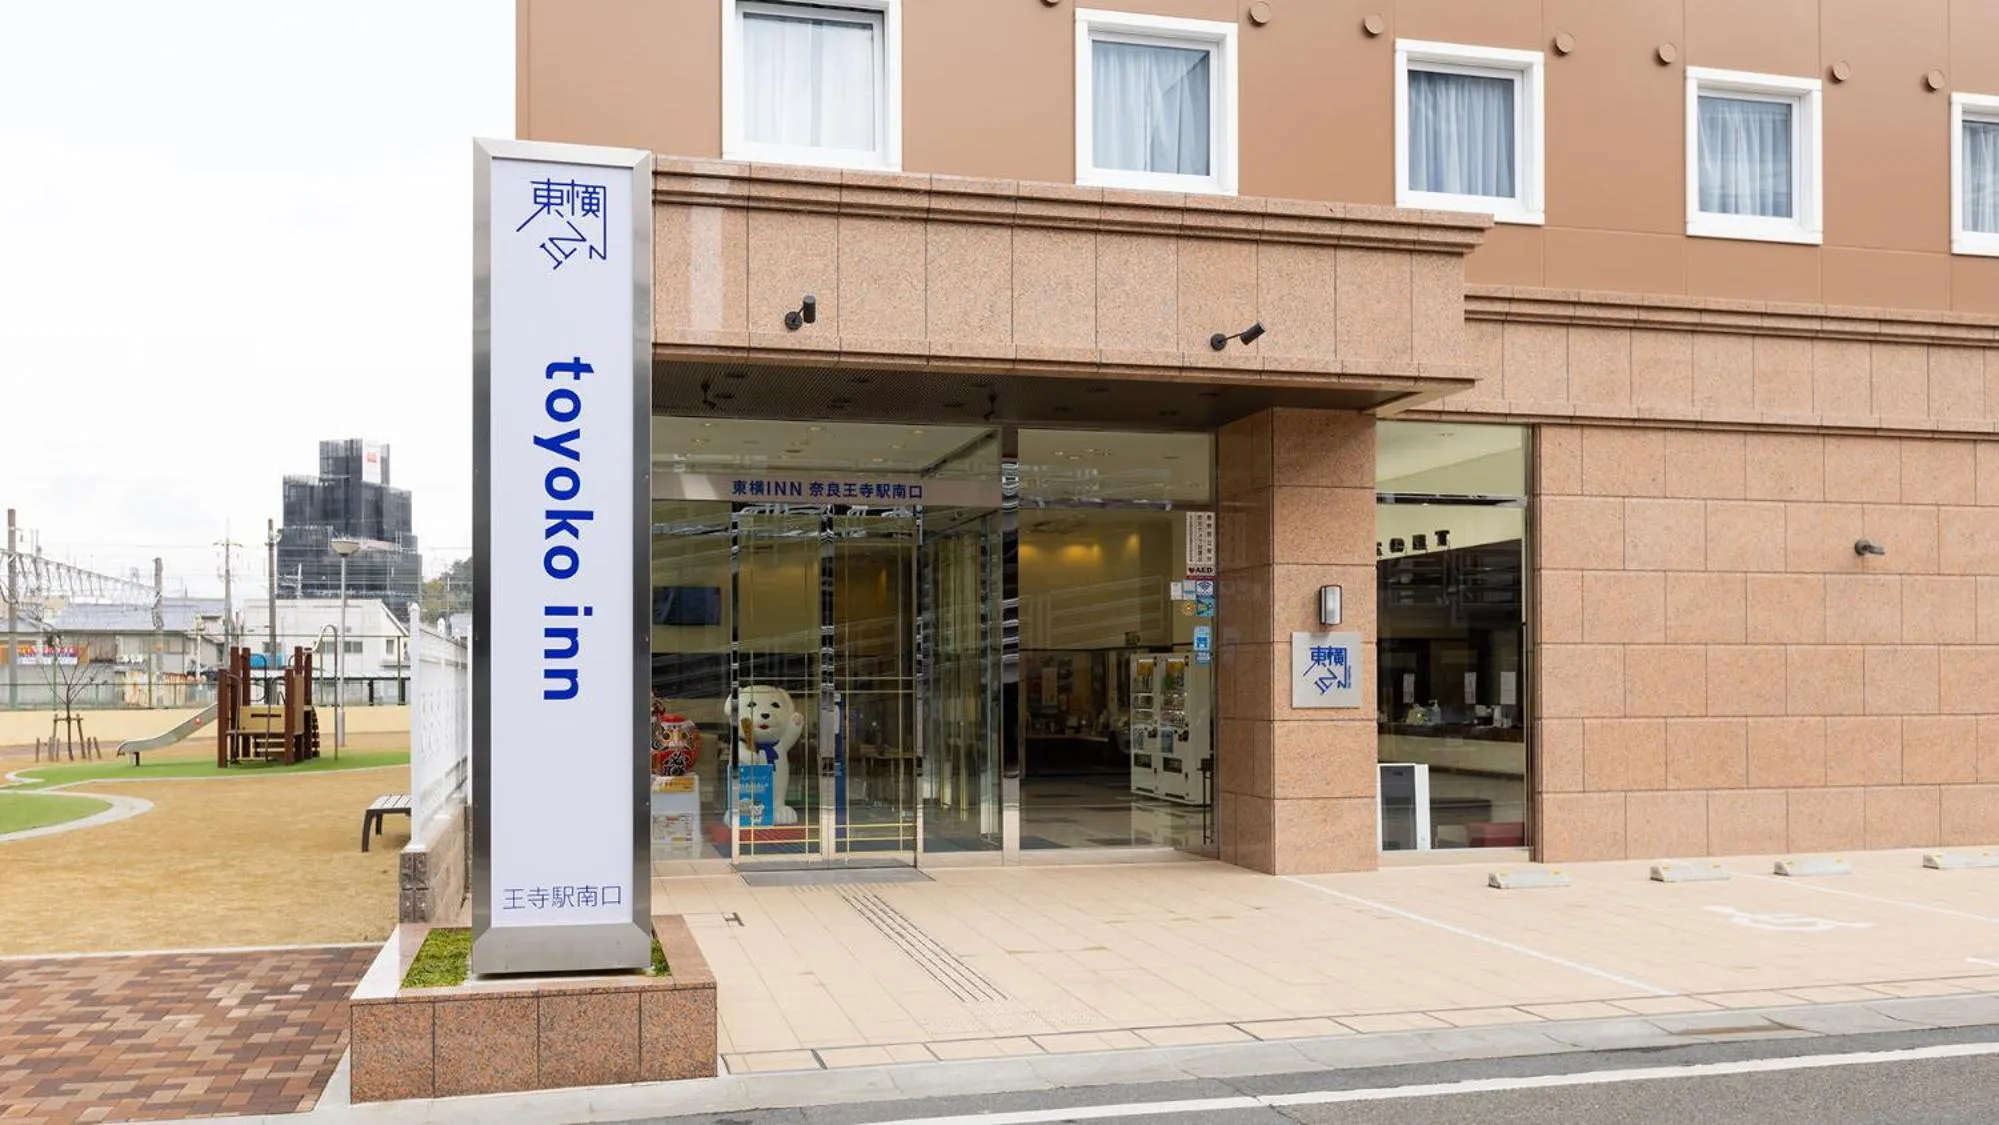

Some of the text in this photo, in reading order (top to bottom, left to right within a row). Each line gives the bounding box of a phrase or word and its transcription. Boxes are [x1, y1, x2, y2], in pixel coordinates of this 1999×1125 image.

[732, 480, 923, 499] 東横INN 奈良王寺駅南口
[533, 357, 594, 701] toyoko inn
[503, 885, 621, 910] 王寺駅南口
